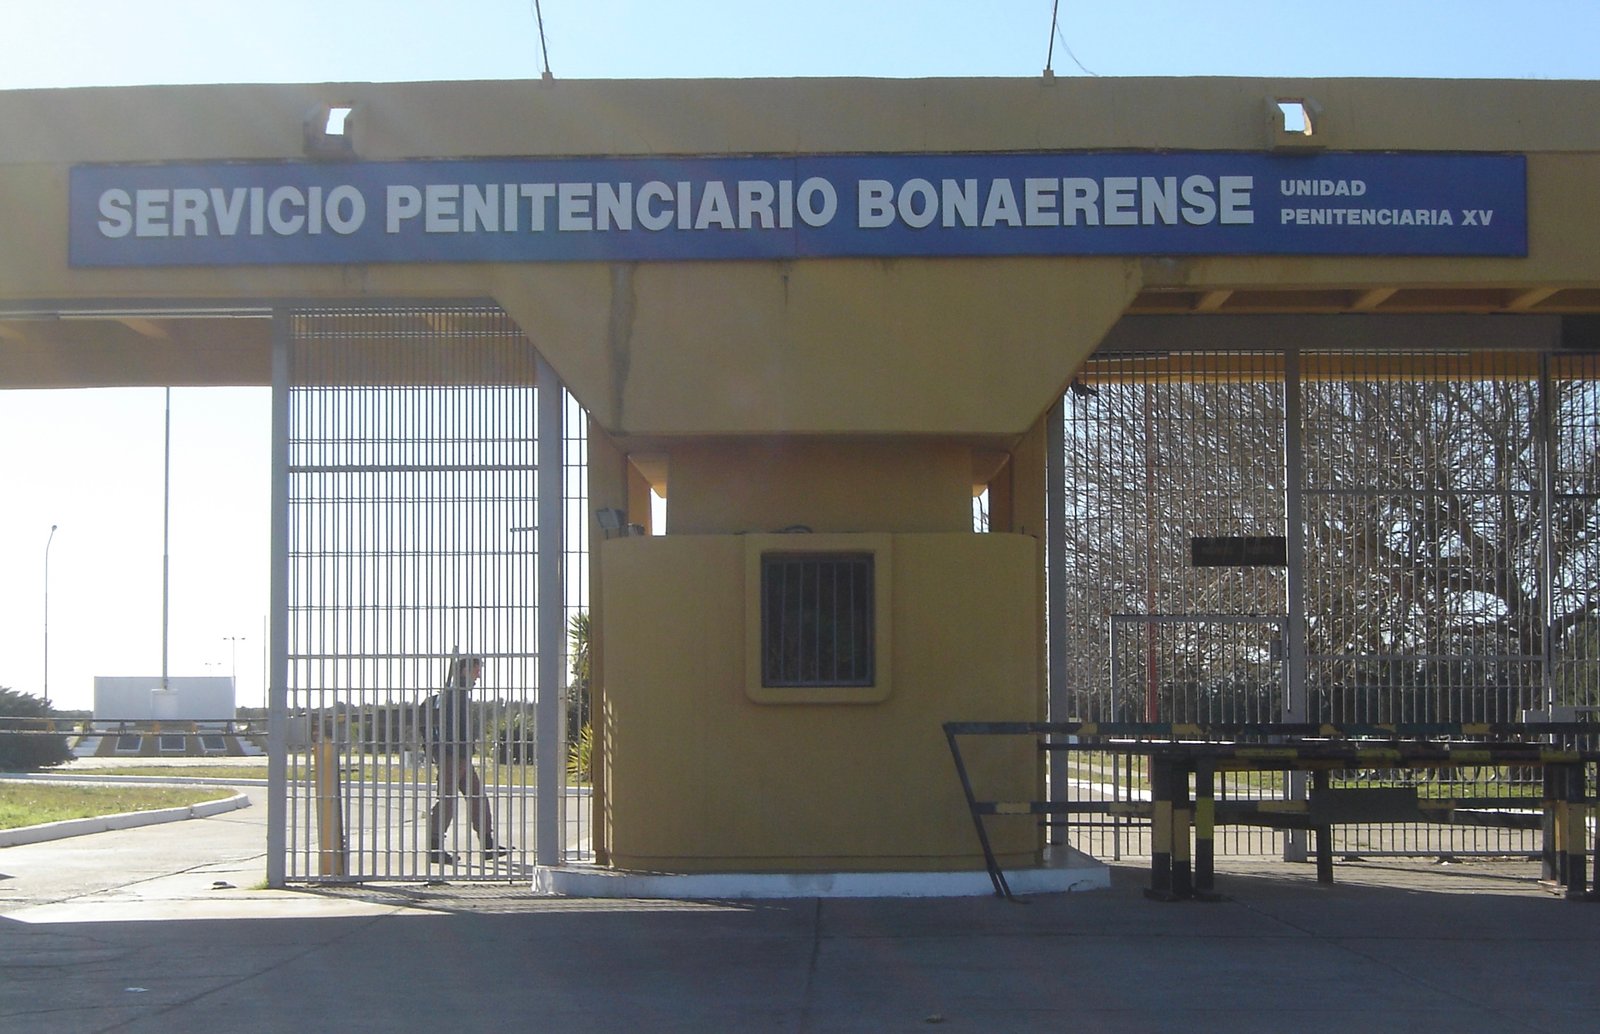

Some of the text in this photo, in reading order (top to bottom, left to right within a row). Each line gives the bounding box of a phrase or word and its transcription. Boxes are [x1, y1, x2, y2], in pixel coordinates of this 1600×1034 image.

[1280, 179, 1367, 196] UNIDAD
[98, 174, 1254, 239] SERVICIO PENITENCIARIO BONAERENSE
[1280, 208, 1494, 226] PENITENCIARIA XV
